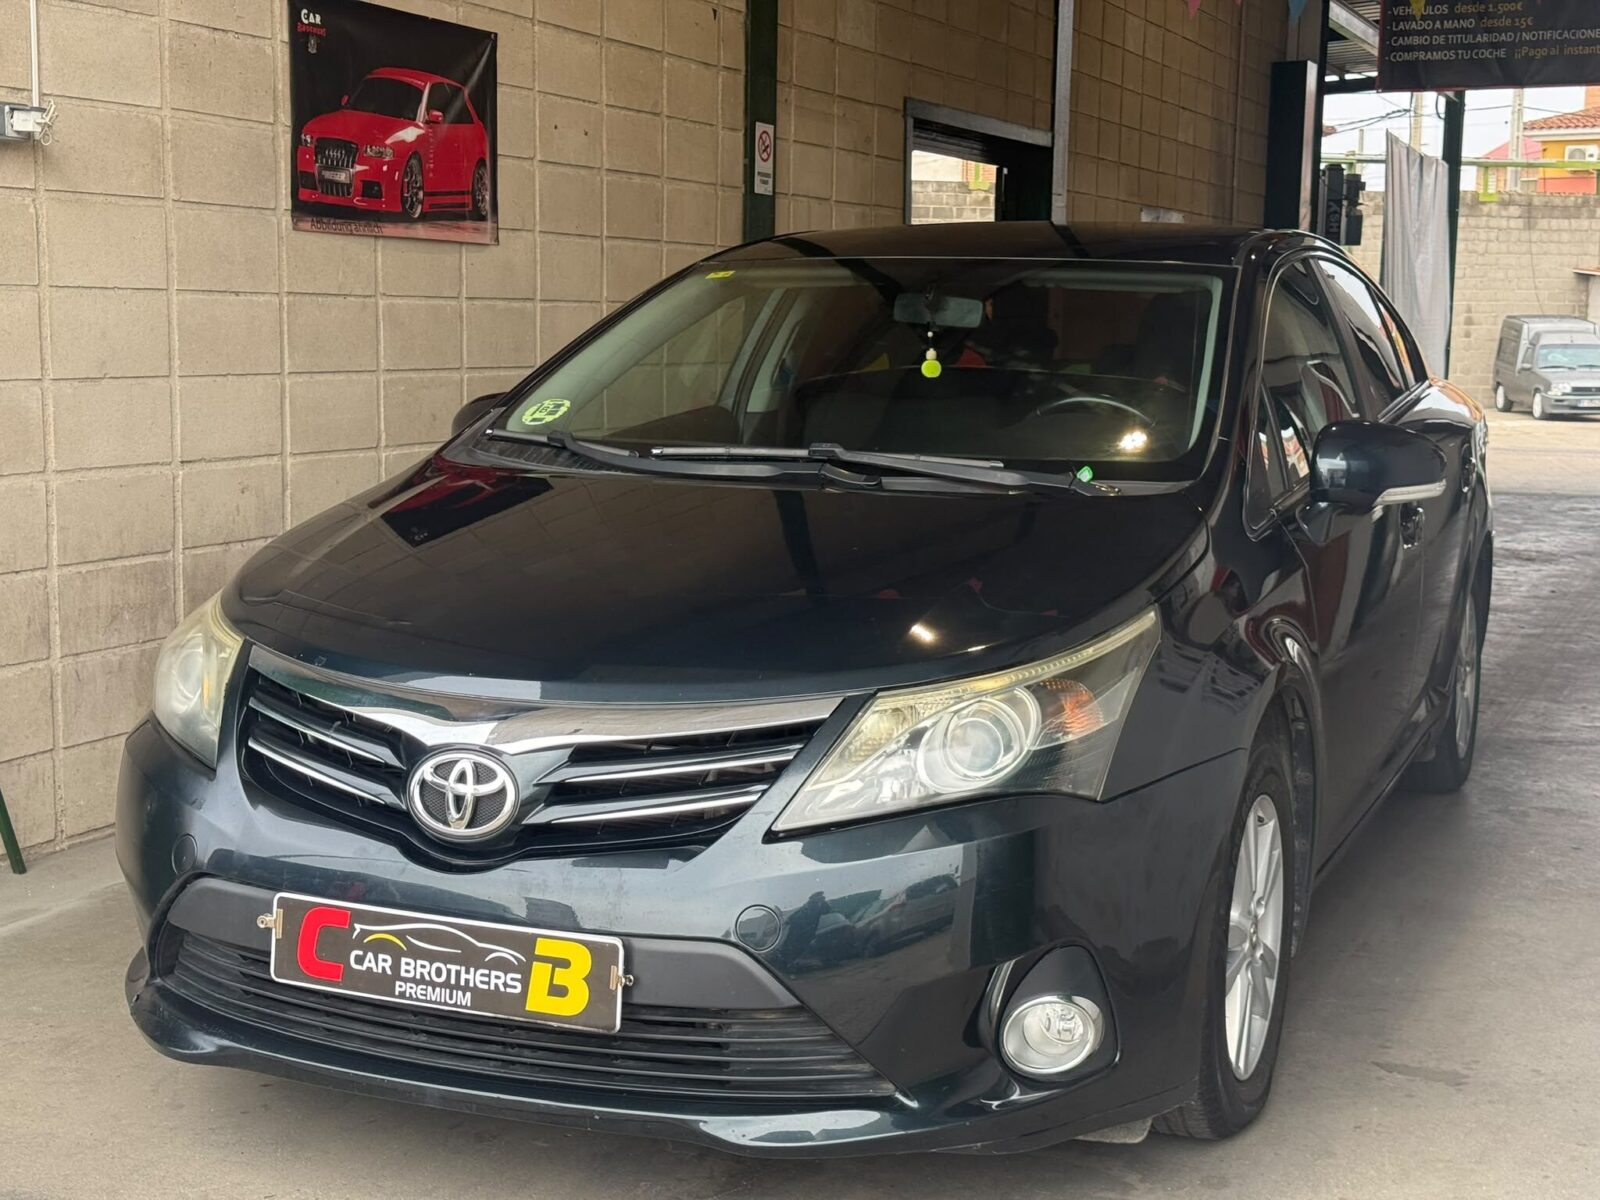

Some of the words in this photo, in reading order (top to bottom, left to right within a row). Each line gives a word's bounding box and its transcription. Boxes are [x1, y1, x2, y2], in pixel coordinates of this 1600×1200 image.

[1392, 5, 1448, 16] VEHULOS
[1454, 2, 1485, 14] desde
[1392, 20, 1433, 32] LAVADO
[1434, 20, 1444, 30] A
[1444, 19, 1475, 30] MANO
[1480, 17, 1511, 28] desde
[1513, 16, 1533, 28] 15€
[1391, 35, 1430, 46] CAMBIO
[1432, 35, 1446, 45] DE
[1448, 32, 1514, 45] TITULARIDAD
[1390, 51, 1455, 62] COMPRAMOS
[1457, 50, 1471, 60] TU
[1472, 48, 1506, 59] COCHE
[1550, 45, 1559, 56] al
[350, 950, 392, 975] CAR
[400, 957, 522, 994] BROTHERS
[395, 981, 471, 1007] PREMIUM
